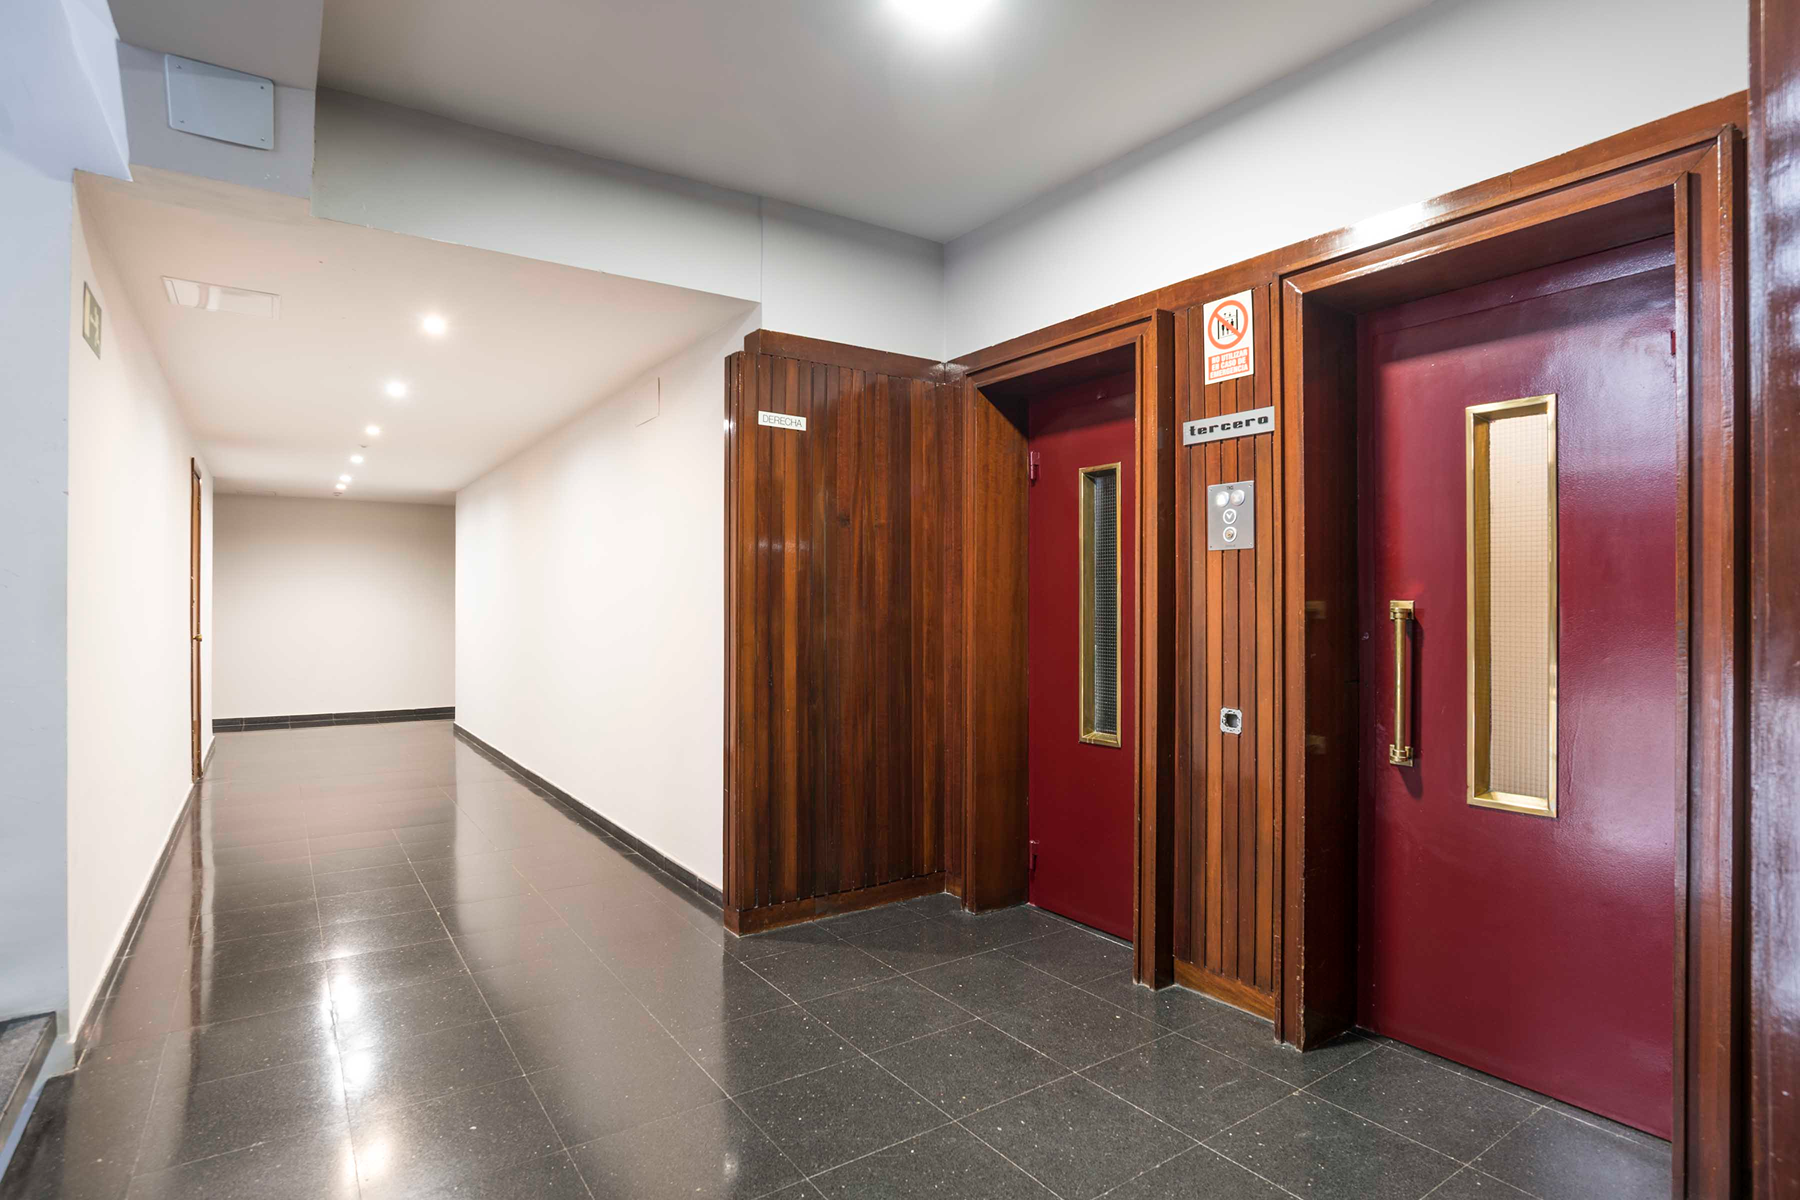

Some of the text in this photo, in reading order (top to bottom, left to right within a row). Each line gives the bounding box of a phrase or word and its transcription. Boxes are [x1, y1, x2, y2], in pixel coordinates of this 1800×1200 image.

[1211, 349, 1247, 364] NO UTILIZAR
[1211, 356, 1246, 371] EN CASO DE
[1210, 364, 1248, 378] EMERGENCIA
[762, 414, 802, 427] DERECHA
[1189, 416, 1268, 436] tercero
